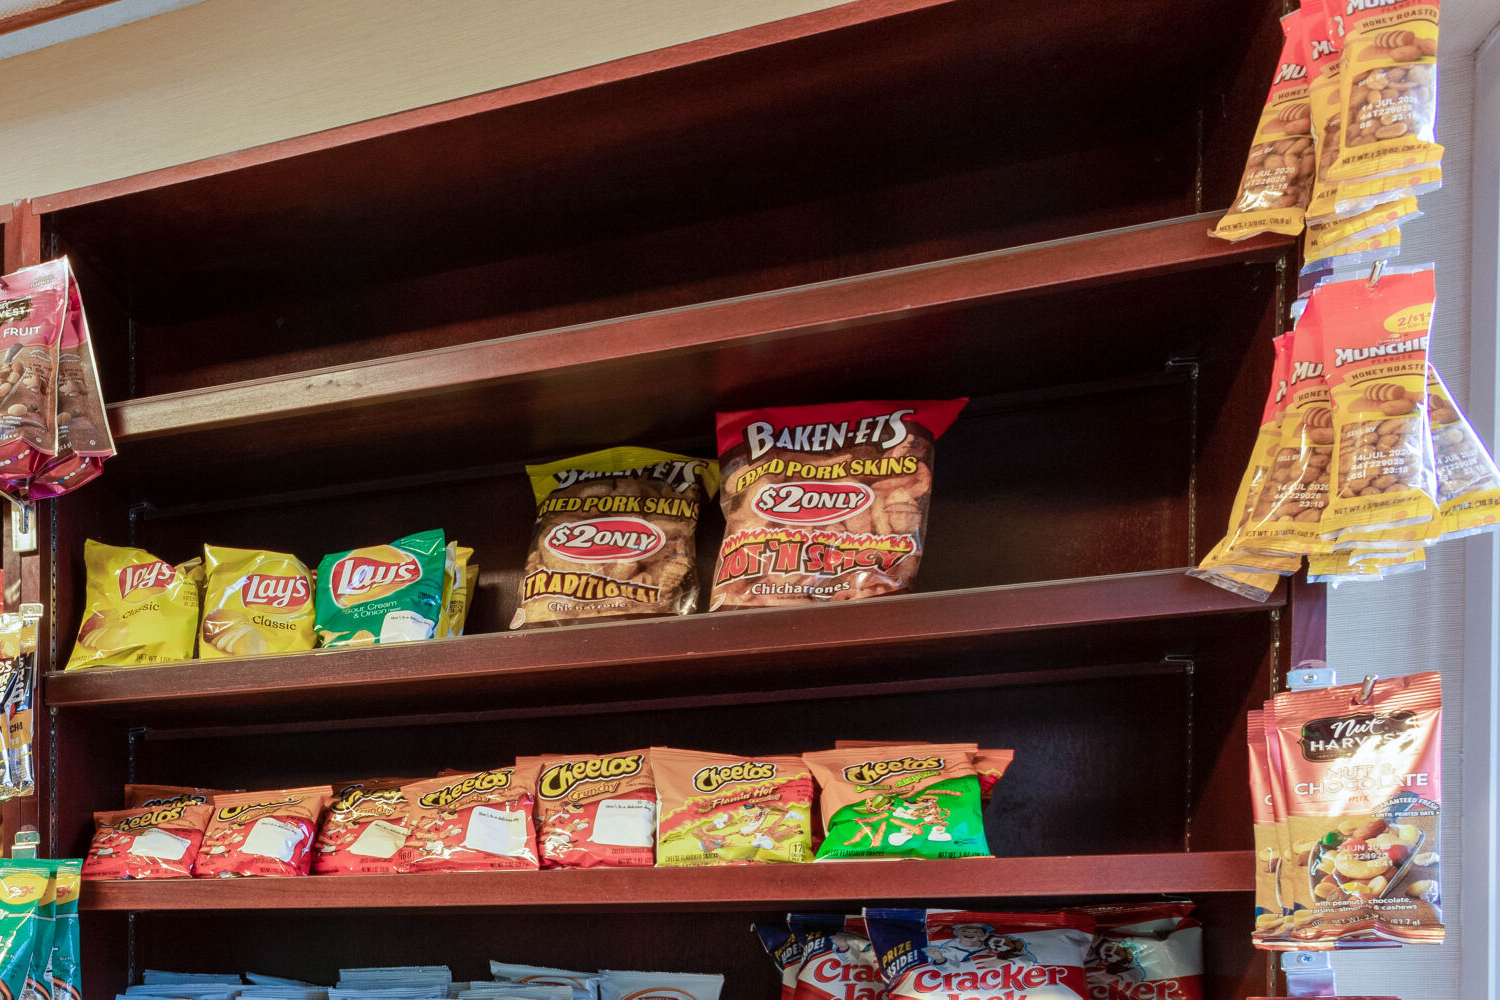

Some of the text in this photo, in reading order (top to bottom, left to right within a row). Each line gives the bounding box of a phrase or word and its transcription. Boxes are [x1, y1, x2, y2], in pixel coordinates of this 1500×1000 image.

[1362, 9, 1437, 29] HONEY ROASTED
[1377, 98, 1396, 107] JUL
[3, 326, 42, 338] FRUIT
[1335, 336, 1428, 367] MUNCHIE
[1351, 368, 1385, 380] HONEY
[1298, 389, 1329, 400] HONEY
[747, 409, 915, 461] BAKEN-ETS
[1346, 429, 1363, 437] SELL
[1366, 451, 1386, 460] JUL
[736, 456, 918, 493] FRIED PORK SKINS
[583, 496, 642, 513] PORK
[1334, 507, 1348, 515] NET
[717, 544, 765, 584] HOT
[124, 562, 172, 597] Lay's
[338, 560, 415, 595] Lay's
[246, 575, 307, 607] Lay's
[751, 582, 850, 595] Chicharrones
[122, 601, 160, 619] Classic
[345, 600, 397, 614] Sour Cream
[360, 608, 387, 618] Onion
[252, 615, 296, 630] Classic
[1330, 718, 1385, 739] Nut
[540, 756, 642, 799] Cheetos
[695, 763, 775, 792] Cheetos
[845, 757, 943, 785] Cheetos
[1327, 765, 1373, 781] NUT
[420, 769, 513, 808] Cheetos
[568, 781, 620, 801] Crunchy
[1293, 773, 1428, 796] CHOCOLATE
[712, 791, 751, 808] Flamin'
[754, 786, 779, 797] Hot
[1419, 799, 1439, 811] FRESH
[882, 940, 912, 968] PRIZE
[913, 962, 1068, 993] Cracker
